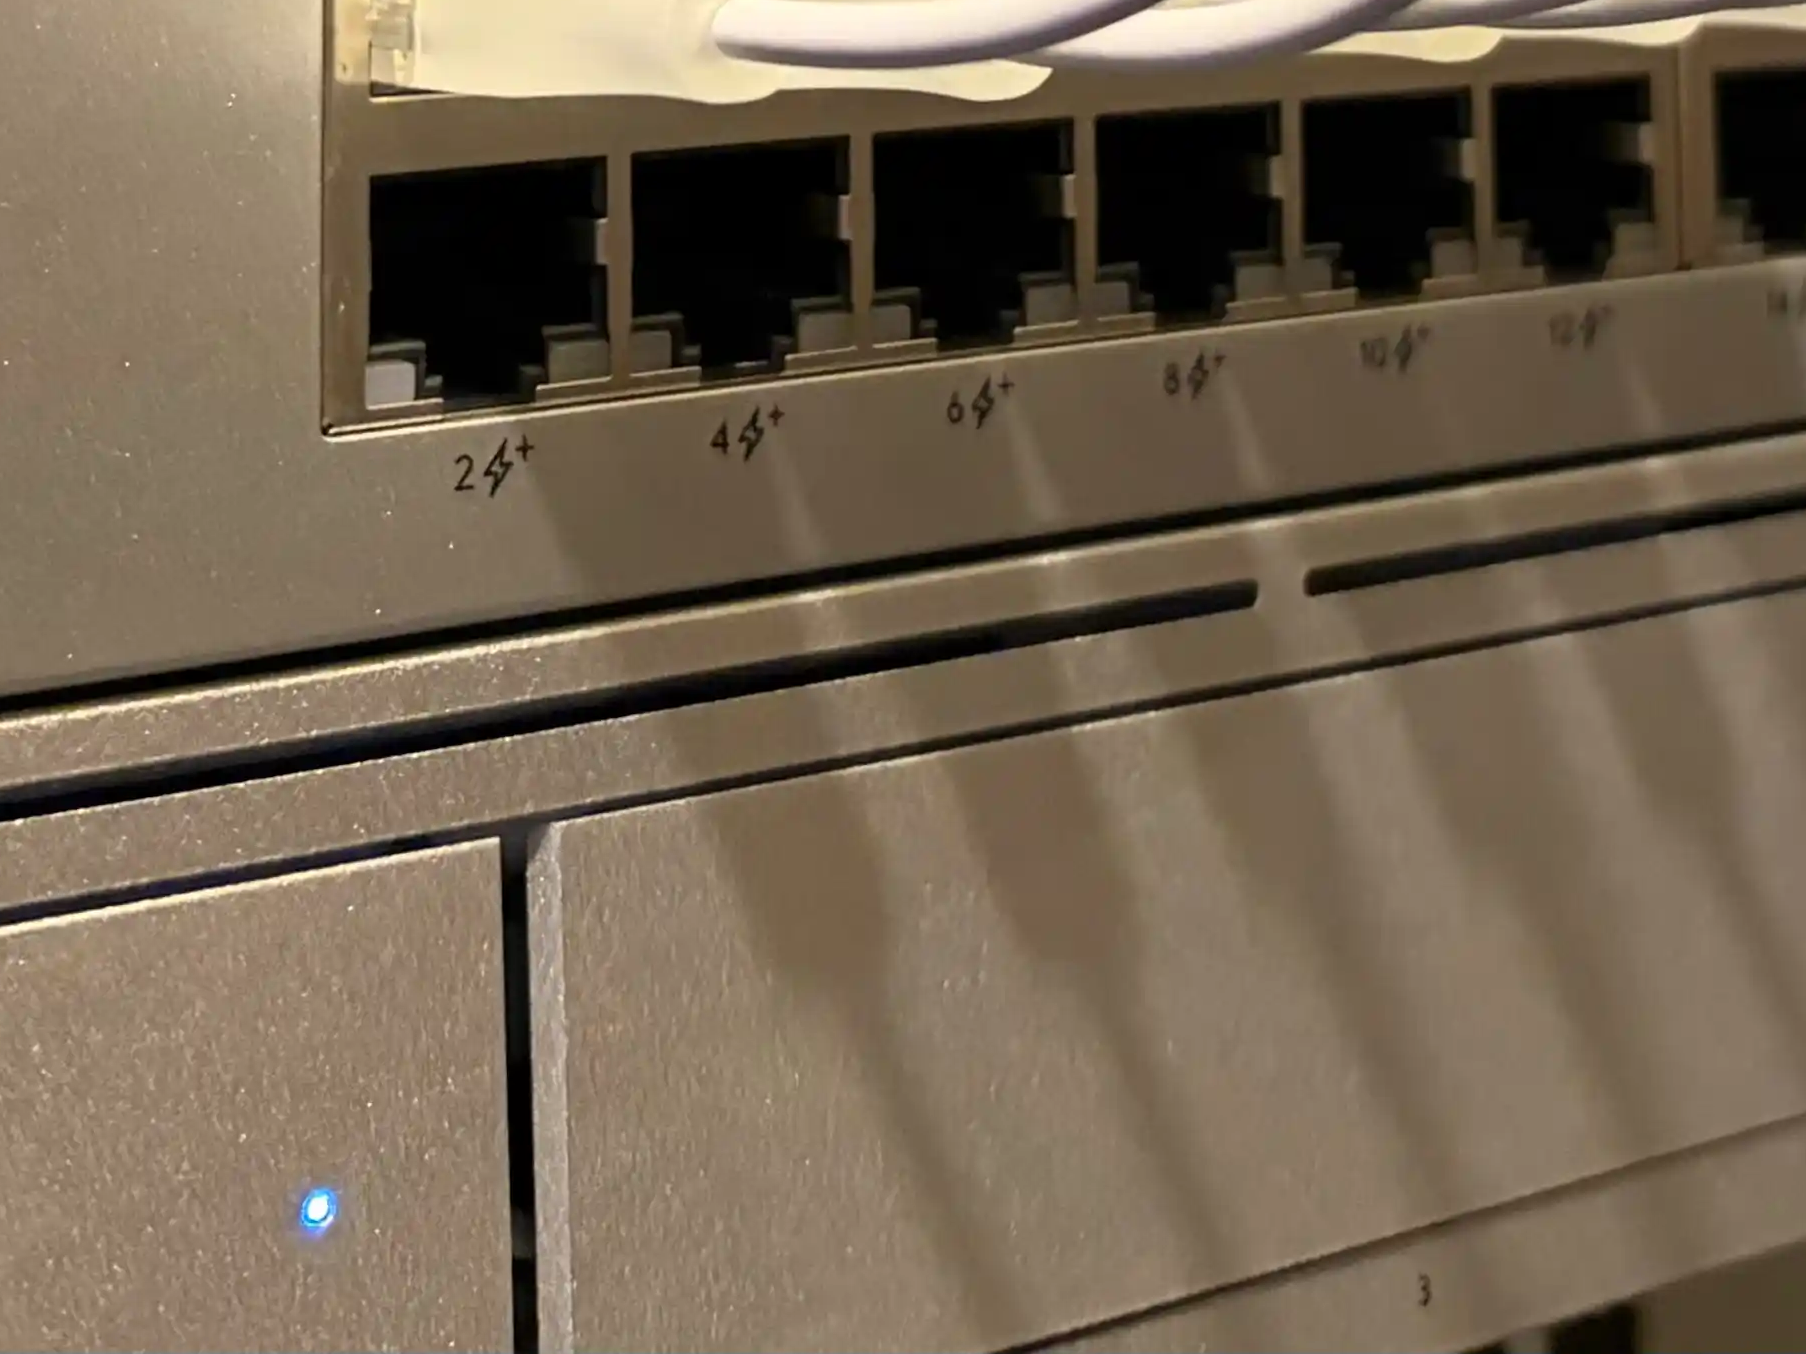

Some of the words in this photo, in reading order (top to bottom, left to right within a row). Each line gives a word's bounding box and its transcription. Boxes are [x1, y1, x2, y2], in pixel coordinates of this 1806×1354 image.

[946, 392, 965, 425] 6
[709, 421, 730, 455] 4
[453, 453, 474, 492] 2
